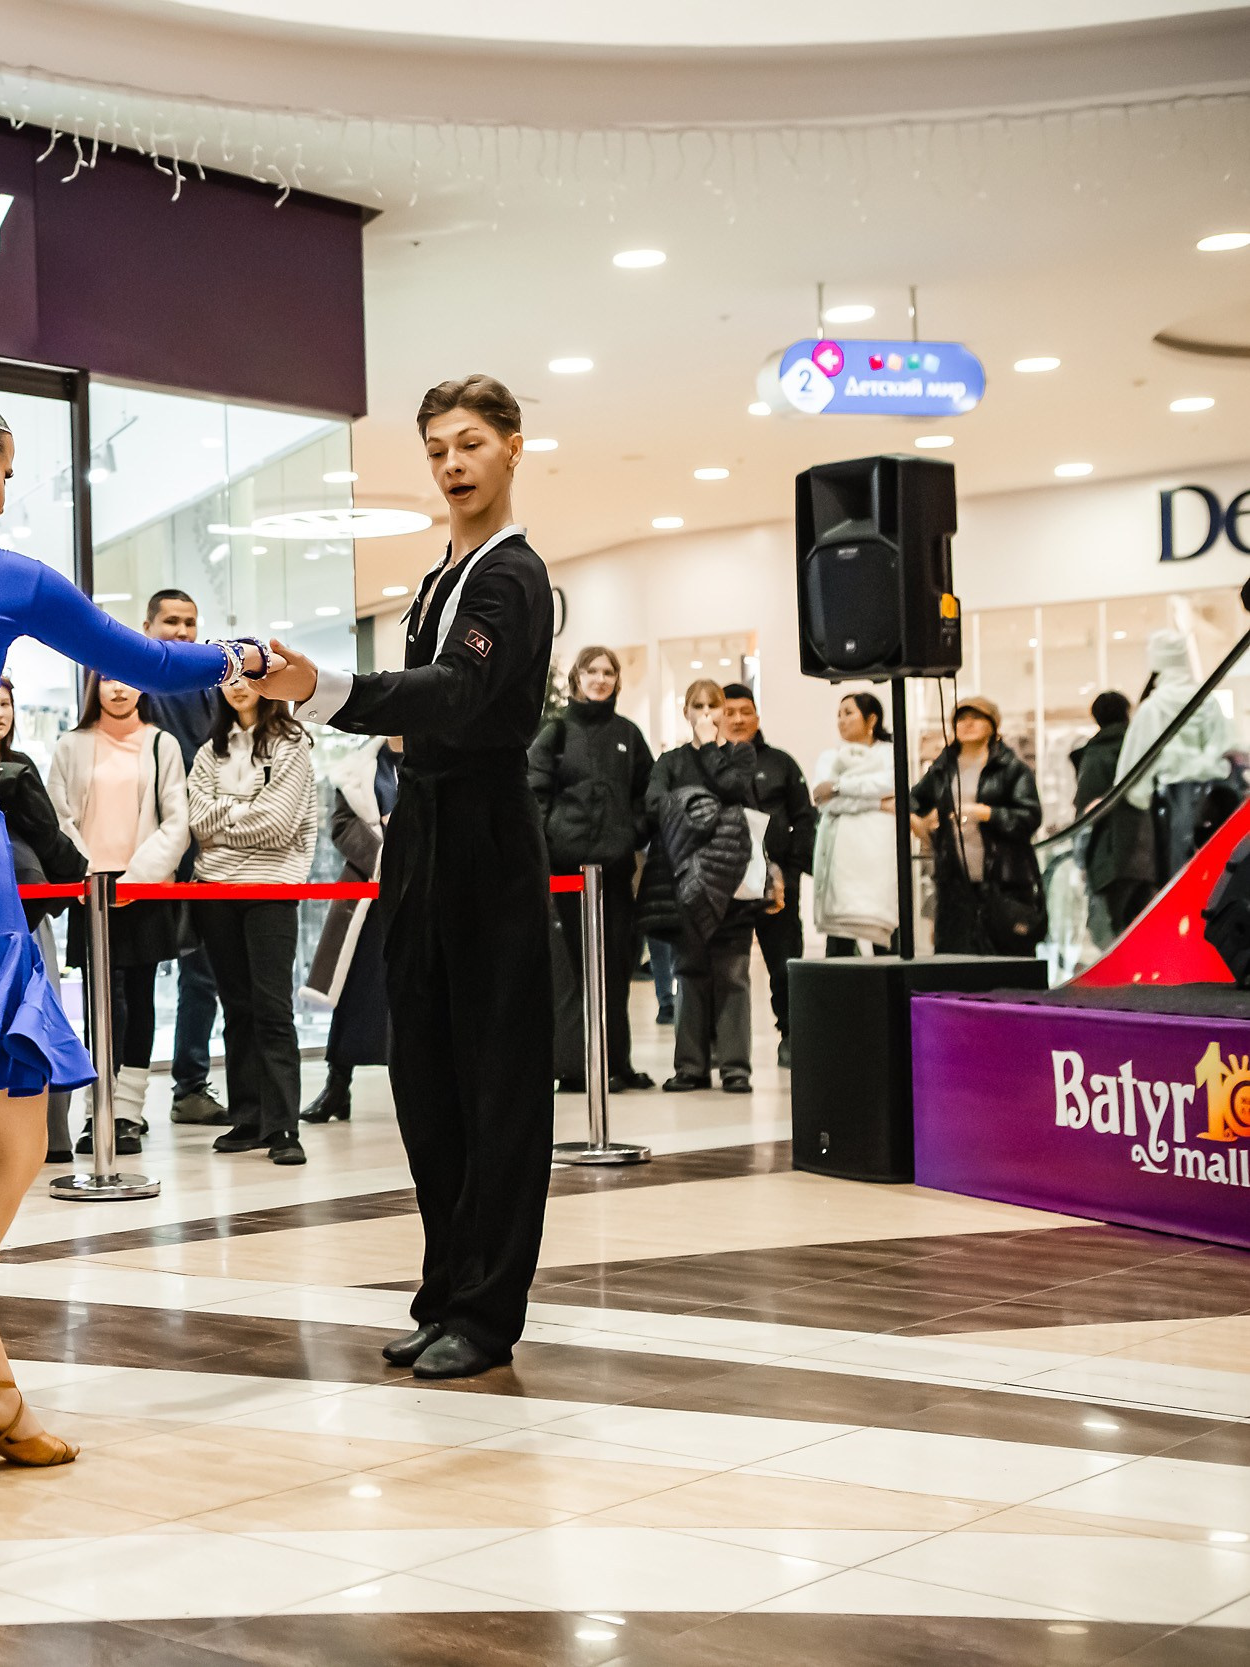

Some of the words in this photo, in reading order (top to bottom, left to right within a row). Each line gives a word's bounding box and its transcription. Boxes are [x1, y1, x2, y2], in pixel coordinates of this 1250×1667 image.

[799, 369, 812, 392] 2
[844, 375, 923, 397] Детский
[925, 381, 967, 404] мир
[1051, 1050, 1196, 1172] Batyr
[1173, 1146, 1250, 1188] mall
